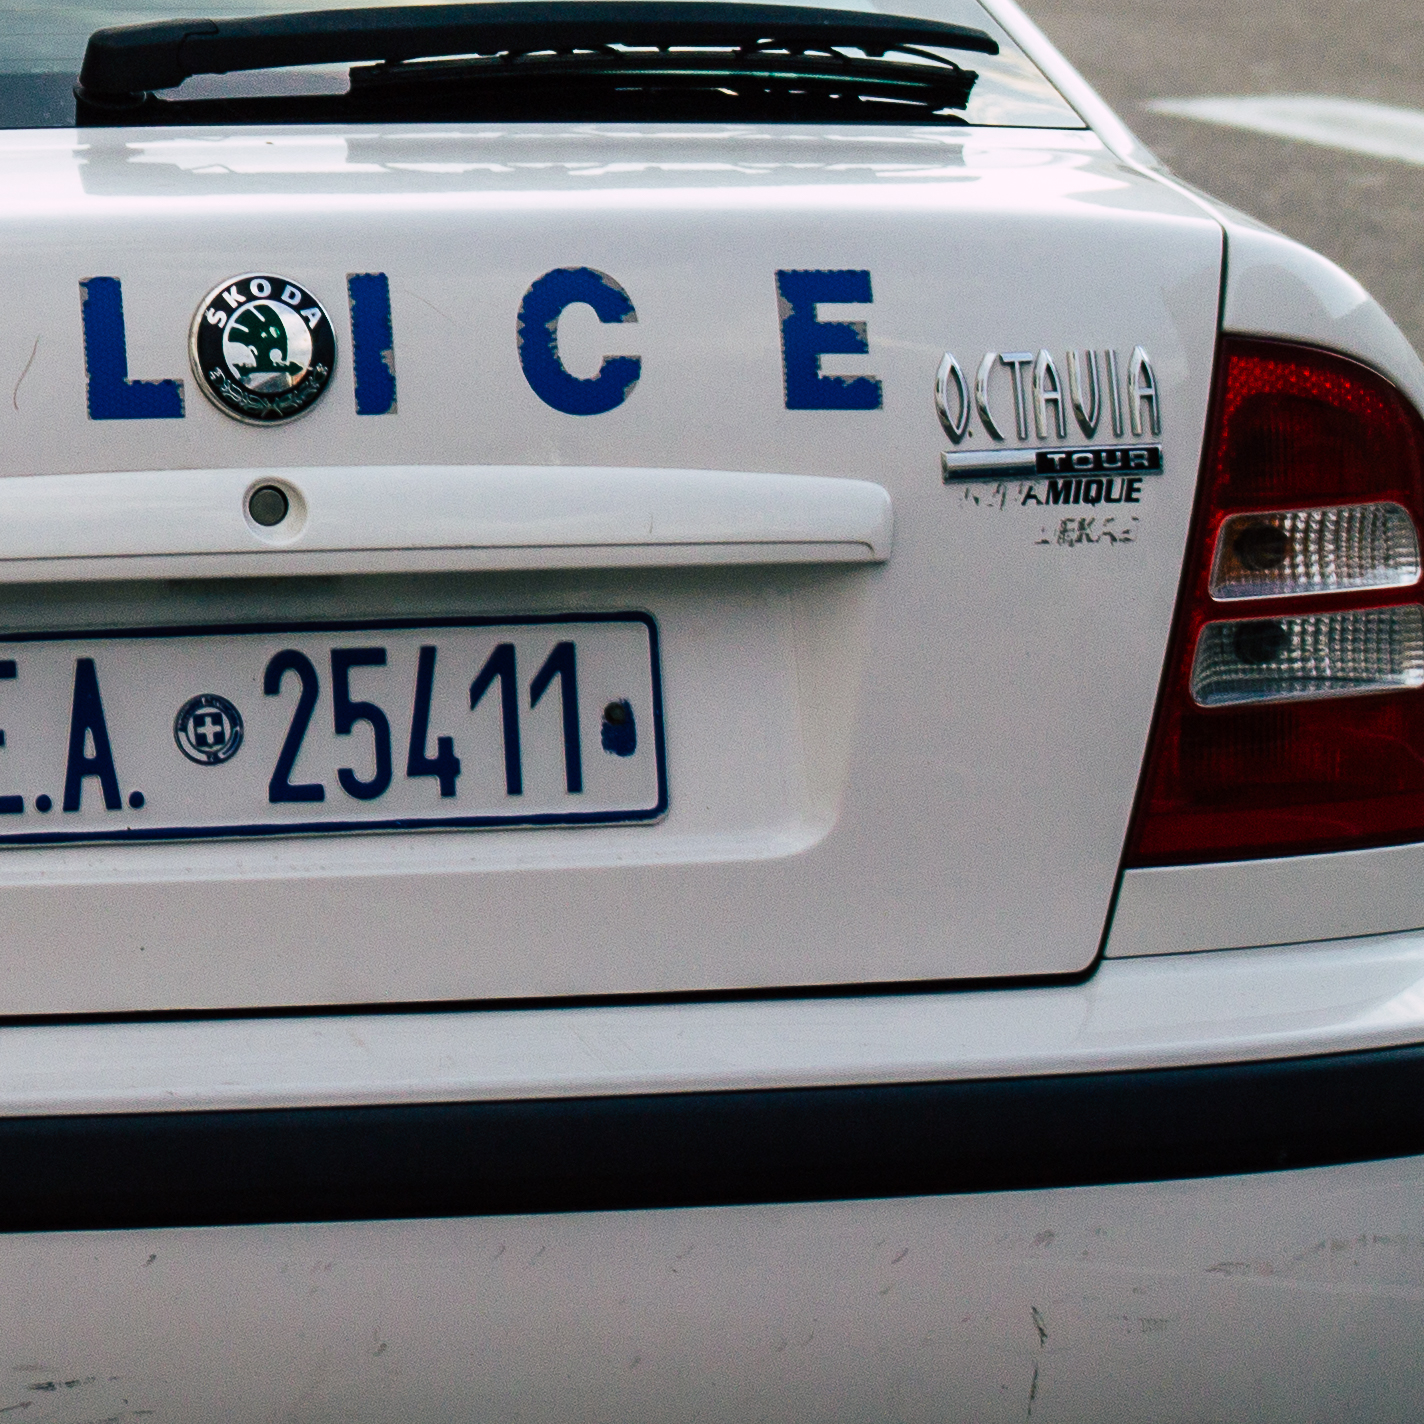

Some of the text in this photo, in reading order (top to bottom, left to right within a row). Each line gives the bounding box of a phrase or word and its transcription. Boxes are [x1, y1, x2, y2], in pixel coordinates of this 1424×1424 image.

[934, 345, 1162, 445] OCTAVIA
[1046, 450, 1150, 470] TOUR
[263, 640, 584, 804] 25411
